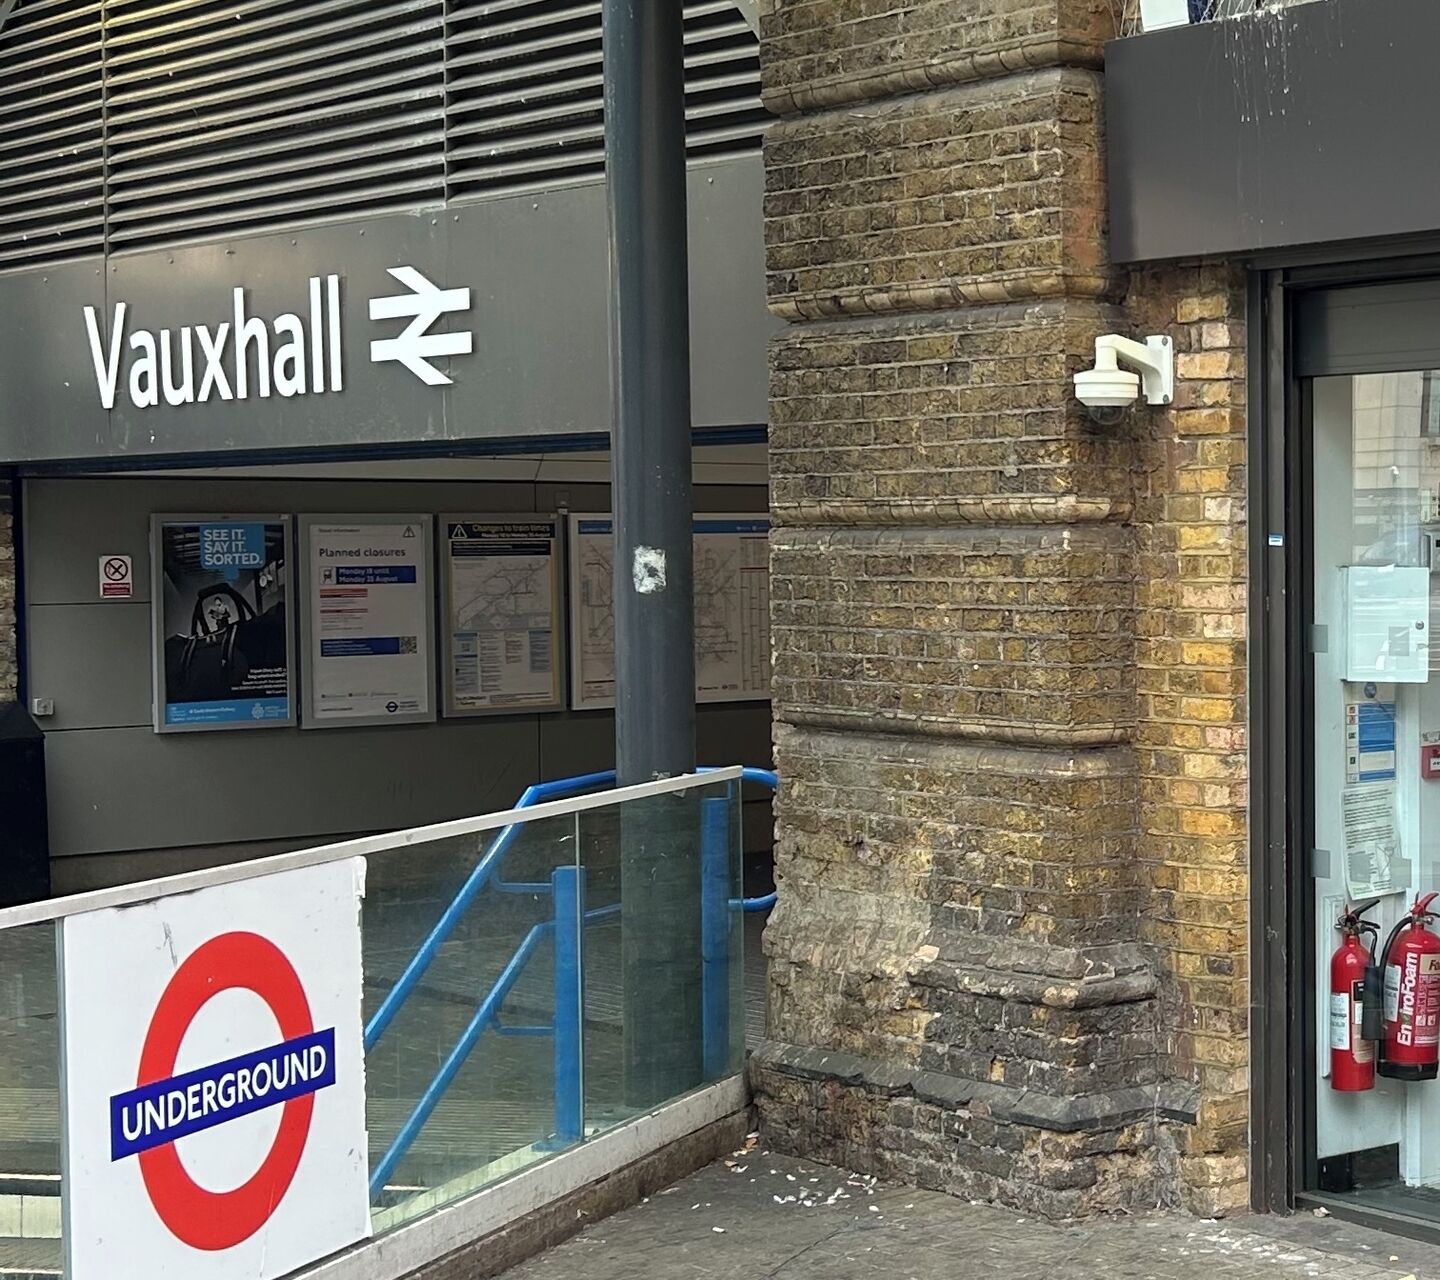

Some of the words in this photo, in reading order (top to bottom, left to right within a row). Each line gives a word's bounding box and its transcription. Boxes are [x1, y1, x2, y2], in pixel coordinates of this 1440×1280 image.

[84, 274, 343, 409] Vauxhall
[203, 529, 229, 541] SEE
[231, 528, 246, 540] IT.
[204, 541, 229, 553] SAY
[232, 541, 246, 552] IT.
[319, 548, 361, 557] Planned
[363, 548, 406, 557] closures
[204, 552, 263, 565] SORTED.
[1397, 952, 1418, 1047] EnviroFoam
[122, 1046, 326, 1143] UNDERGROUND
